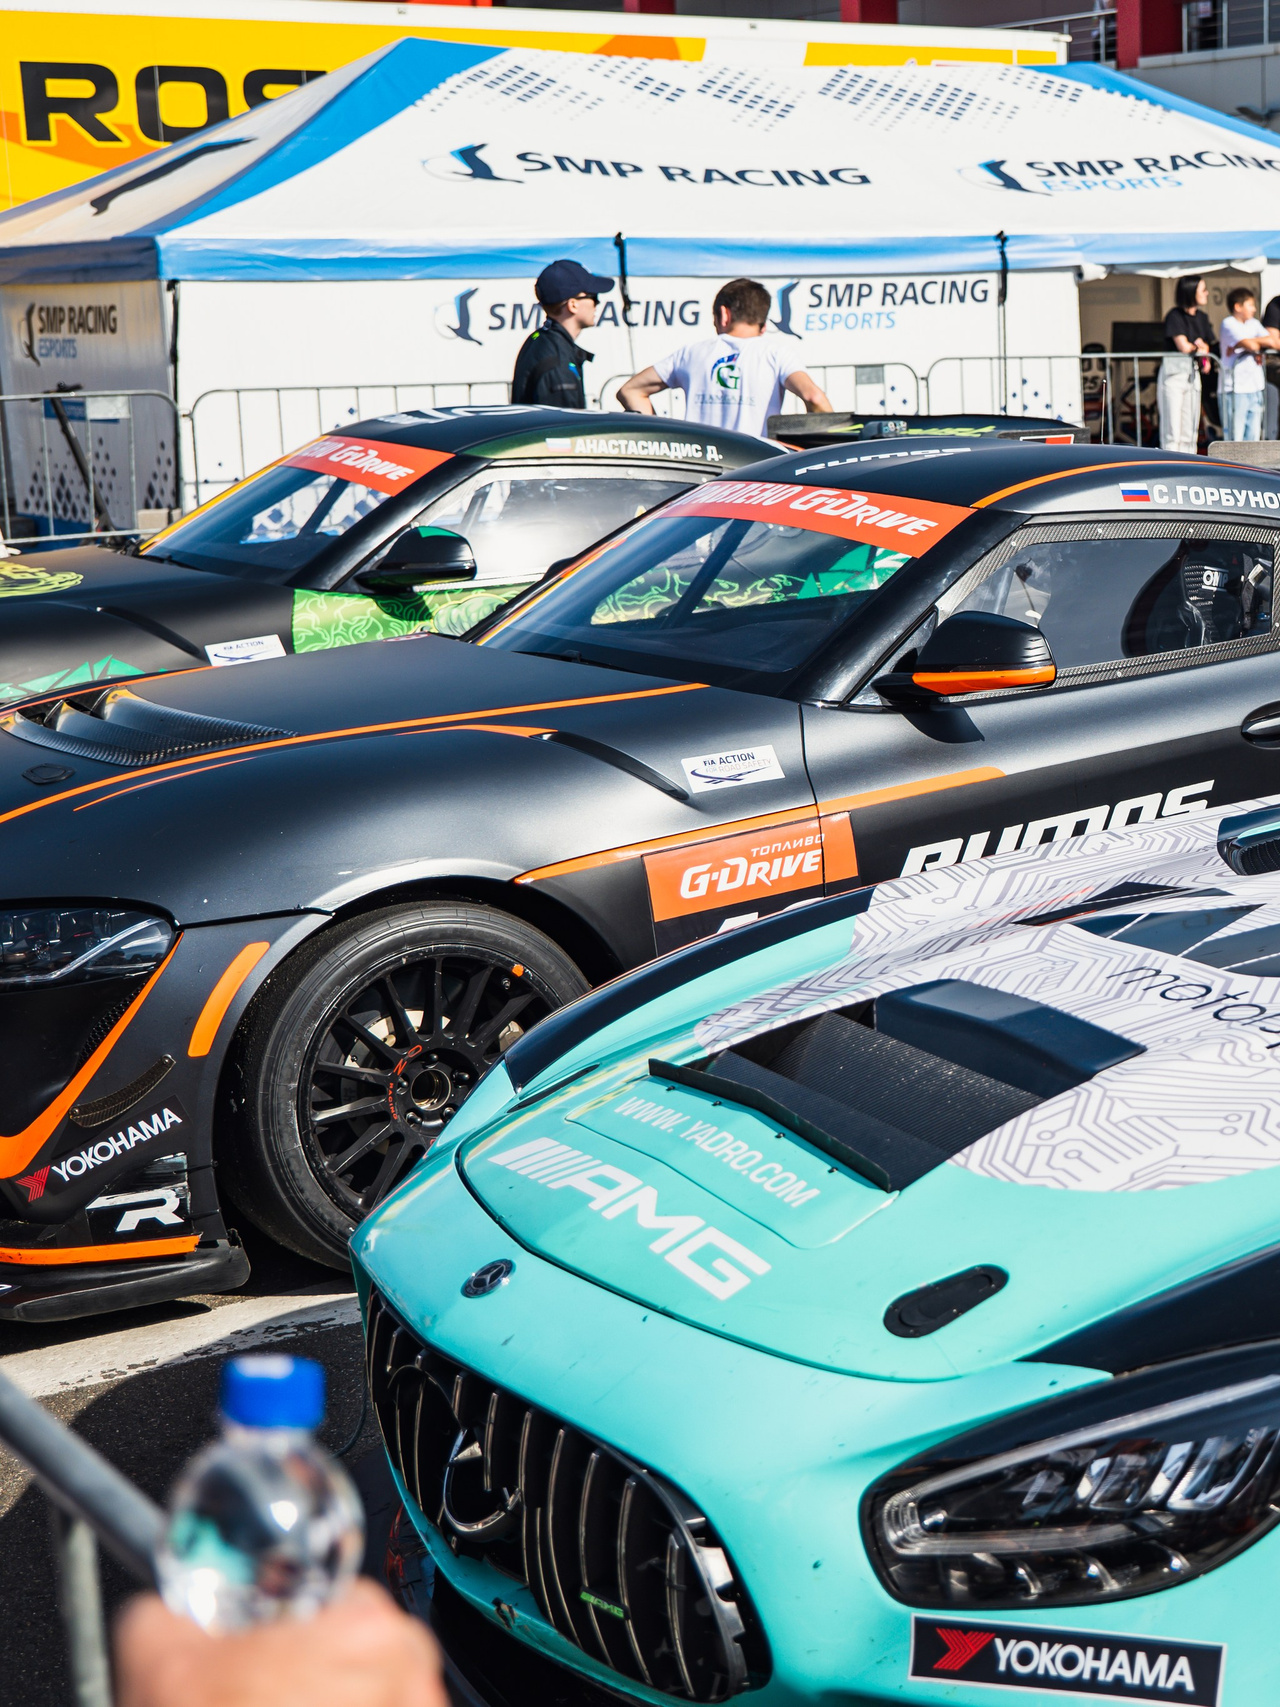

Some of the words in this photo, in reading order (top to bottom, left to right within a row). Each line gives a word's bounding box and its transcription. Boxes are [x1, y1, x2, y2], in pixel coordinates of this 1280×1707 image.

[18, 61, 329, 143] RO
[516, 151, 644, 178] SMP
[658, 163, 872, 187] RACING
[1026, 159, 1124, 177] SMP
[1041, 174, 1184, 192] ESPORTS
[809, 283, 873, 308] SMP
[881, 279, 989, 306] RACING
[37, 306, 66, 334] SMP
[67, 304, 118, 334] RACING
[488, 303, 546, 331] SM
[596, 300, 701, 328] ACING
[804, 311, 896, 331] ESPORTS
[38, 338, 78, 359] ESPORTS
[574, 437, 702, 459] АНАСТАСИАДИС
[706, 444, 723, 462] Д.
[1202, 570, 1229, 587] OMP
[719, 751, 756, 766] ACTION
[719, 762, 742, 774] ROAD
[742, 758, 772, 770] SAFETY
[751, 833, 826, 858] ТОПЛИВО
[51, 1107, 183, 1183] YOKOHAMA
[993, 1638, 1196, 1693] YOKOHAMA
